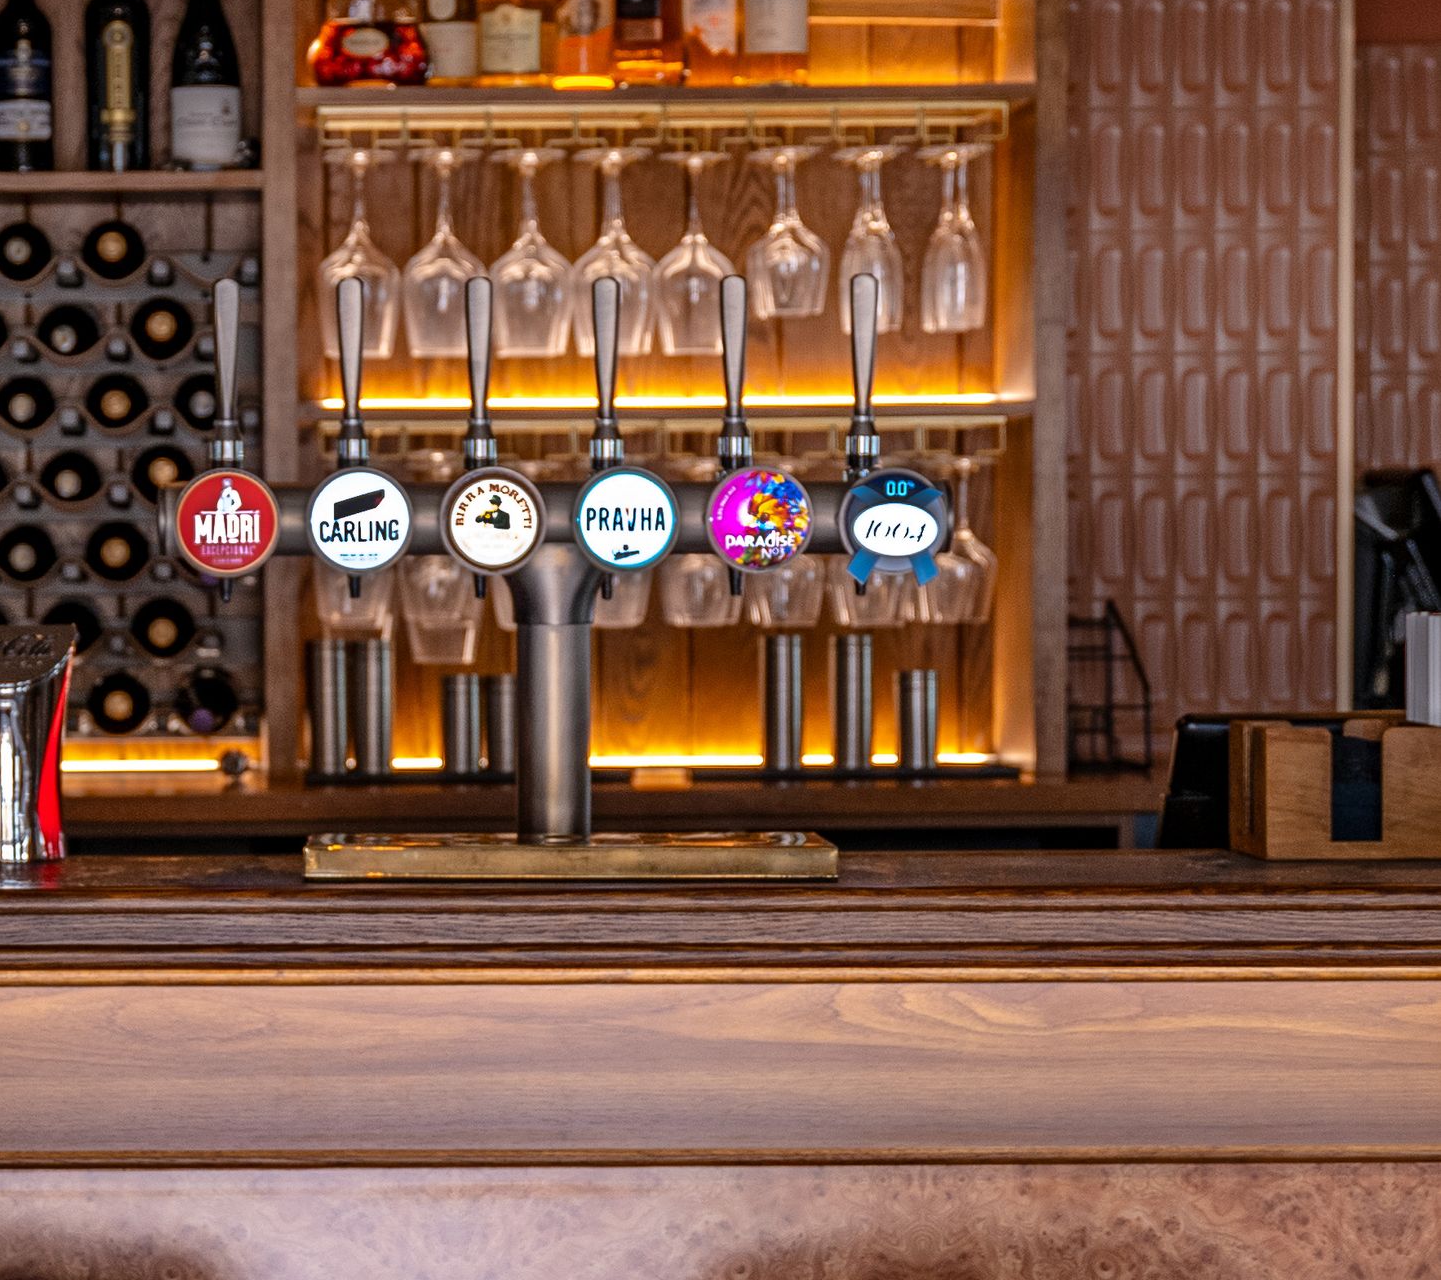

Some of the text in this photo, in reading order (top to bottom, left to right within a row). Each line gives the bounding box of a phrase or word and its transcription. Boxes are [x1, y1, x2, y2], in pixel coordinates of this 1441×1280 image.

[455, 483, 532, 529] BIRRA MORETTI
[319, 519, 399, 543] CARLING
[586, 507, 665, 531] PRAVHA
